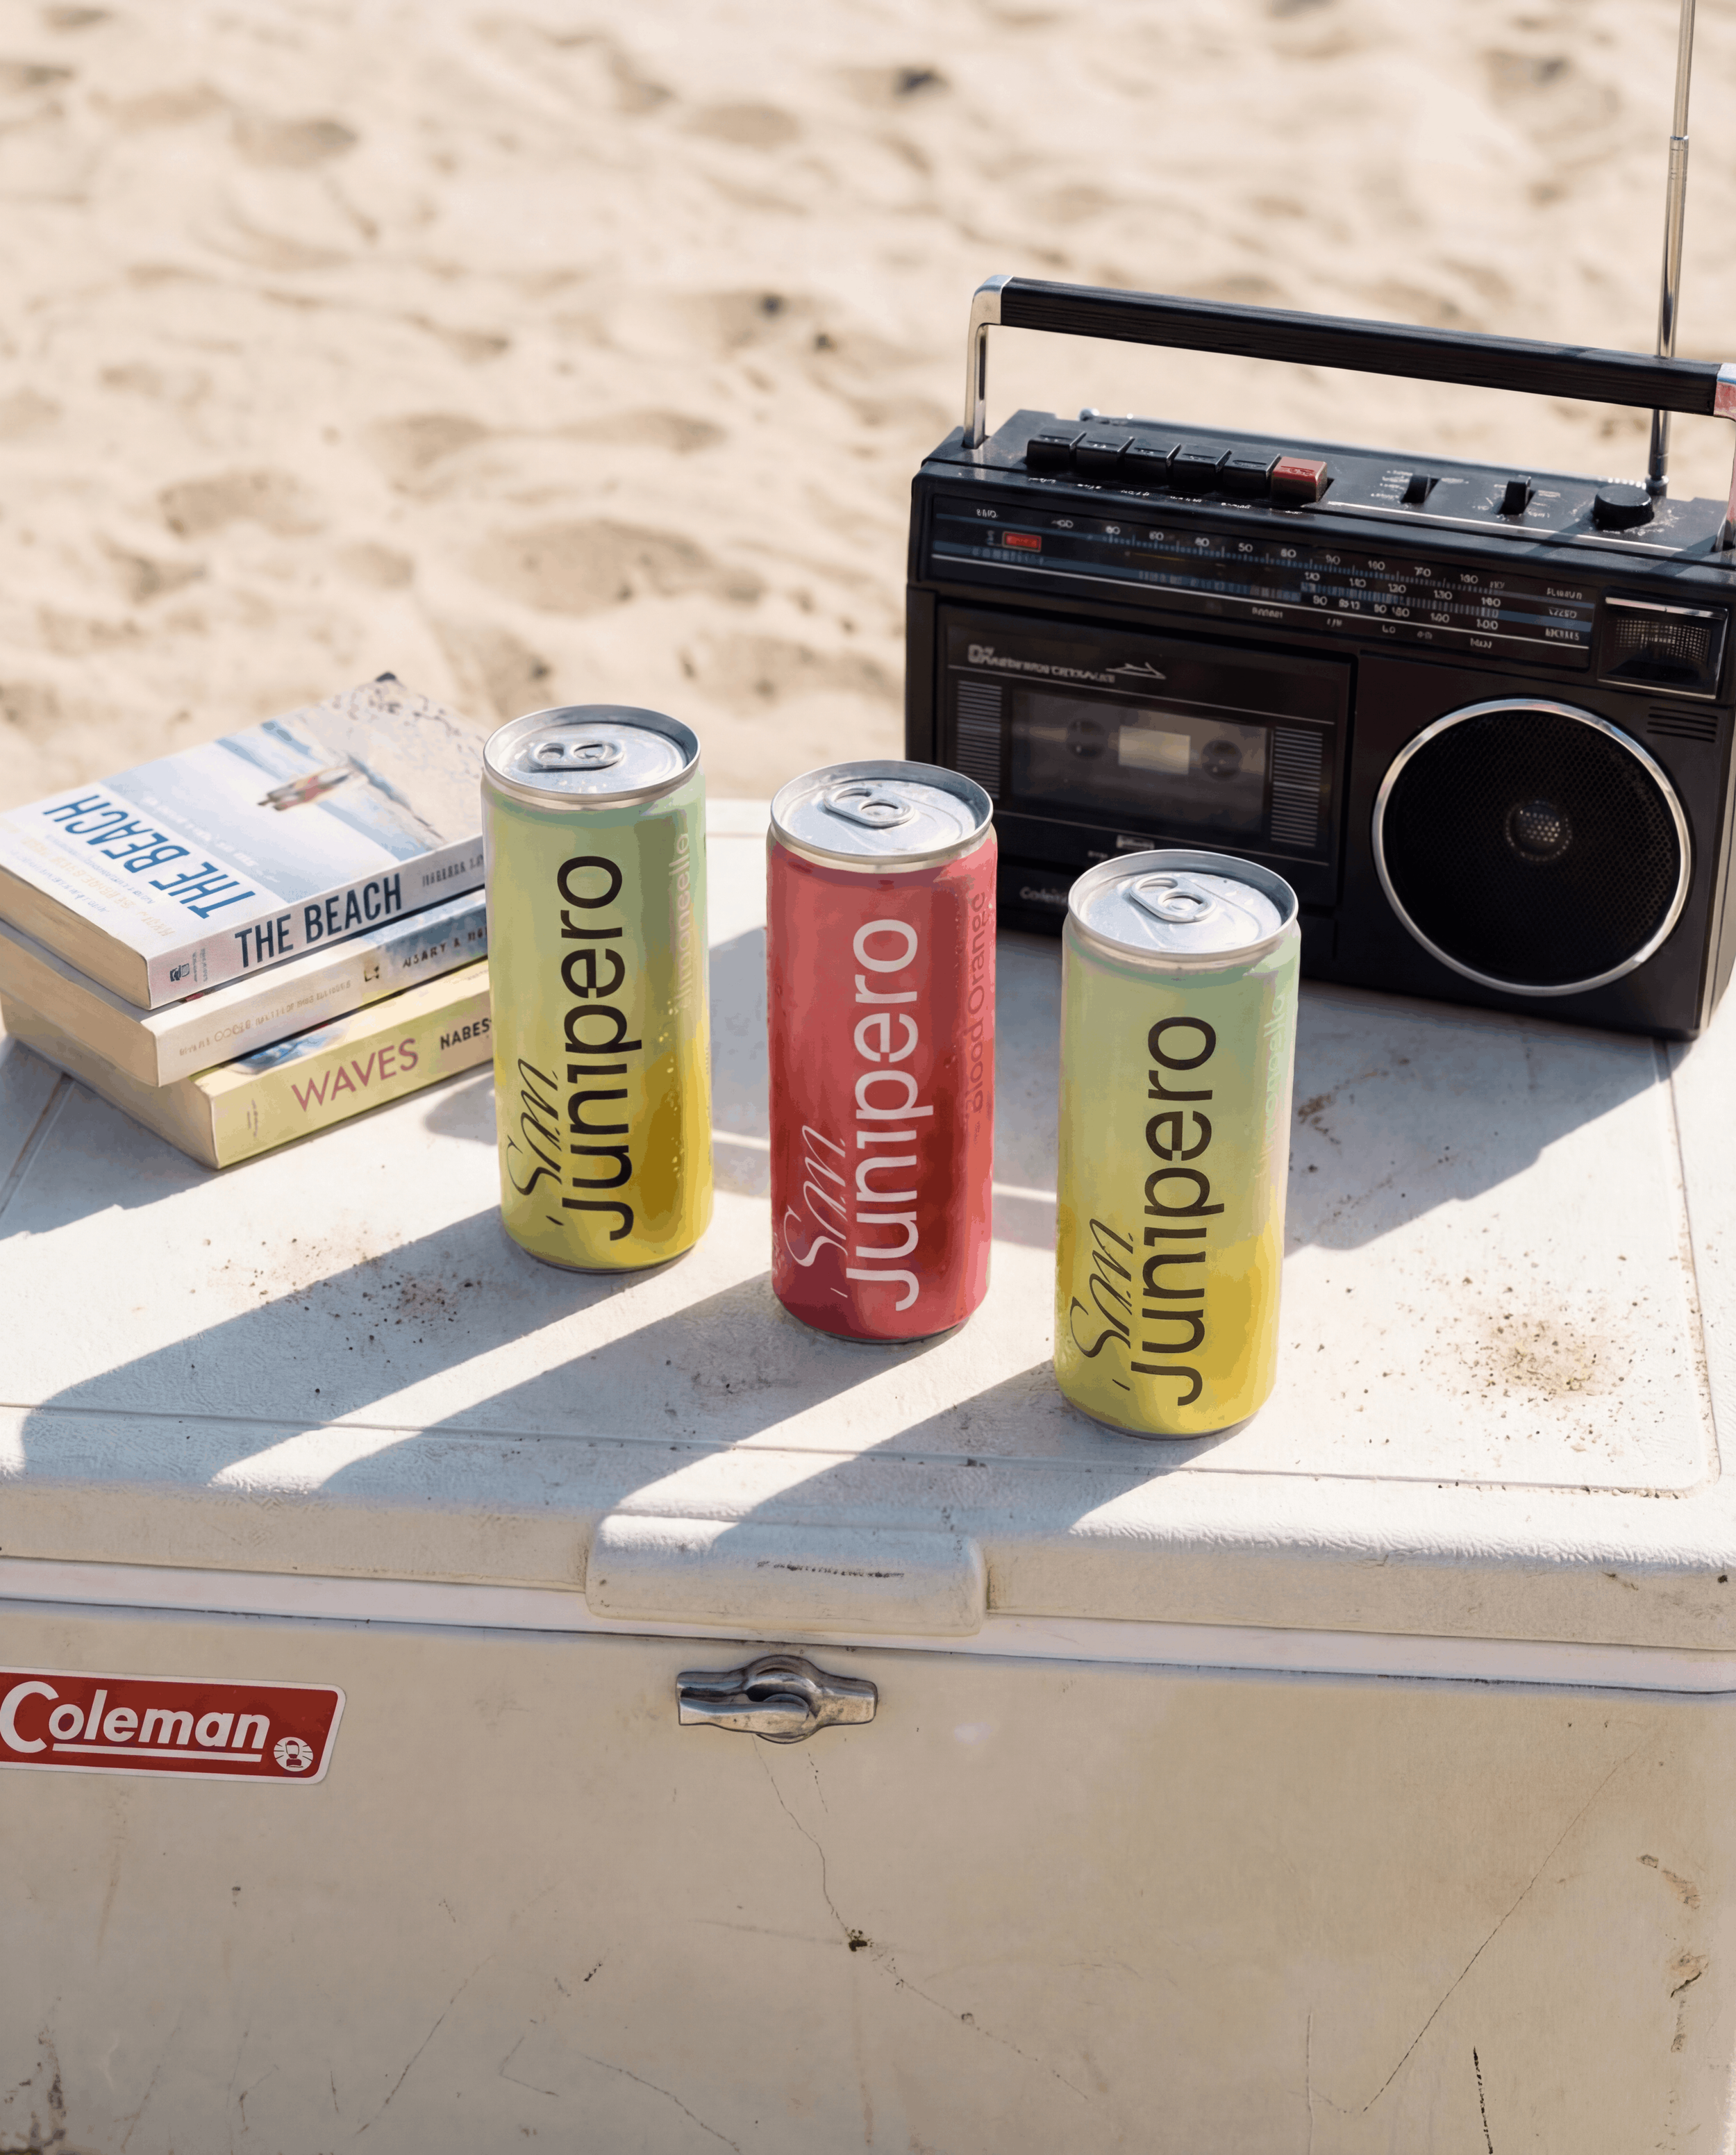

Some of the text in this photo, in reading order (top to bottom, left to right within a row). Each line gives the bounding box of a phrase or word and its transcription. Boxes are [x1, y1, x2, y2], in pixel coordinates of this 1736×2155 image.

[43, 795, 191, 874] BEACH
[149, 854, 256, 920] THE
[235, 913, 294, 967] THE
[305, 873, 403, 944] BEACH
[292, 1038, 419, 1112] WAVES
[440, 1017, 492, 1050] NABES
[557, 856, 642, 1241] Junipero
[959, 1017, 984, 1113] Blood
[845, 919, 933, 1311] Junipero
[1130, 1016, 1225, 1406] Junipero
[0, 1681, 271, 1754] Coleman
